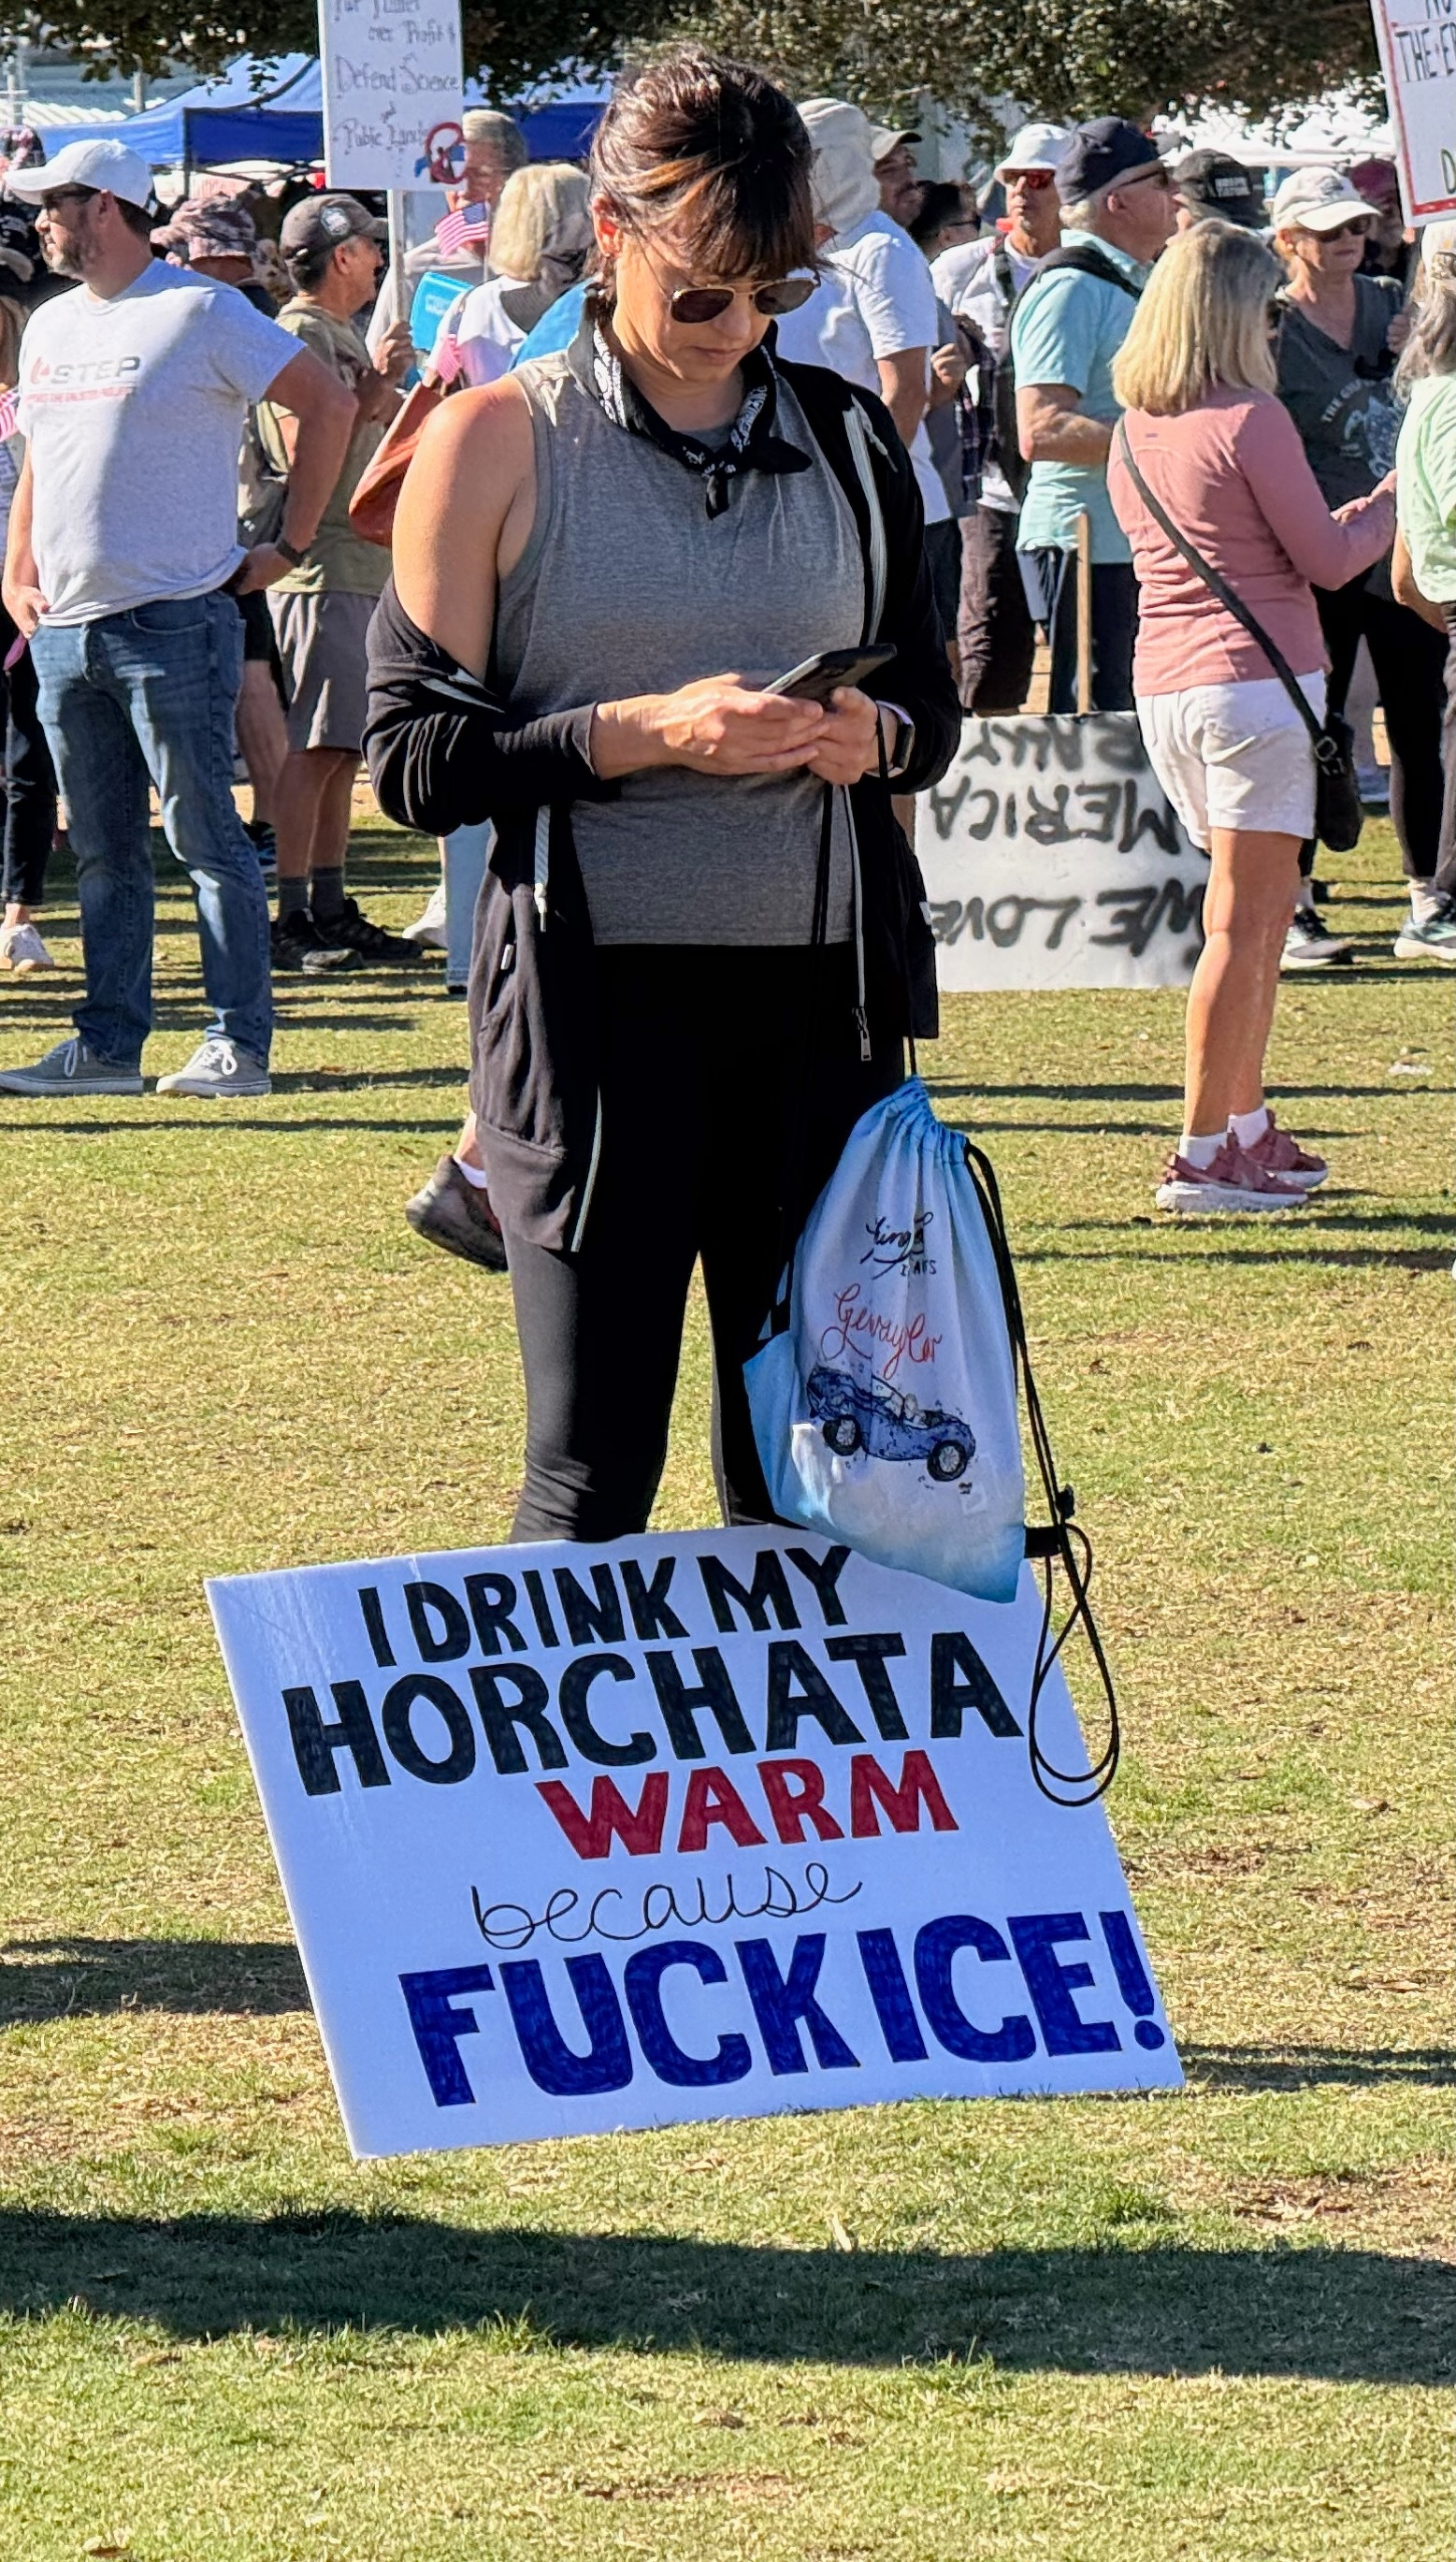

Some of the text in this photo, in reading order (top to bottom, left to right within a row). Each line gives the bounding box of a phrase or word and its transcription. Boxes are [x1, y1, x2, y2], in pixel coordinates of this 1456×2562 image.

[336, 52, 460, 94] Defend Science
[1394, 27, 1438, 82] THE
[332, 118, 382, 152] Public
[50, 356, 140, 384] STEP
[928, 878, 1206, 958] WE LOVE
[358, 1544, 852, 1668] I DRINK MY
[281, 1630, 1025, 1796] HORCHATA
[534, 1748, 959, 1860] WARM
[471, 1862, 863, 1950] because
[397, 1909, 1166, 2107] FUCK ICE!
